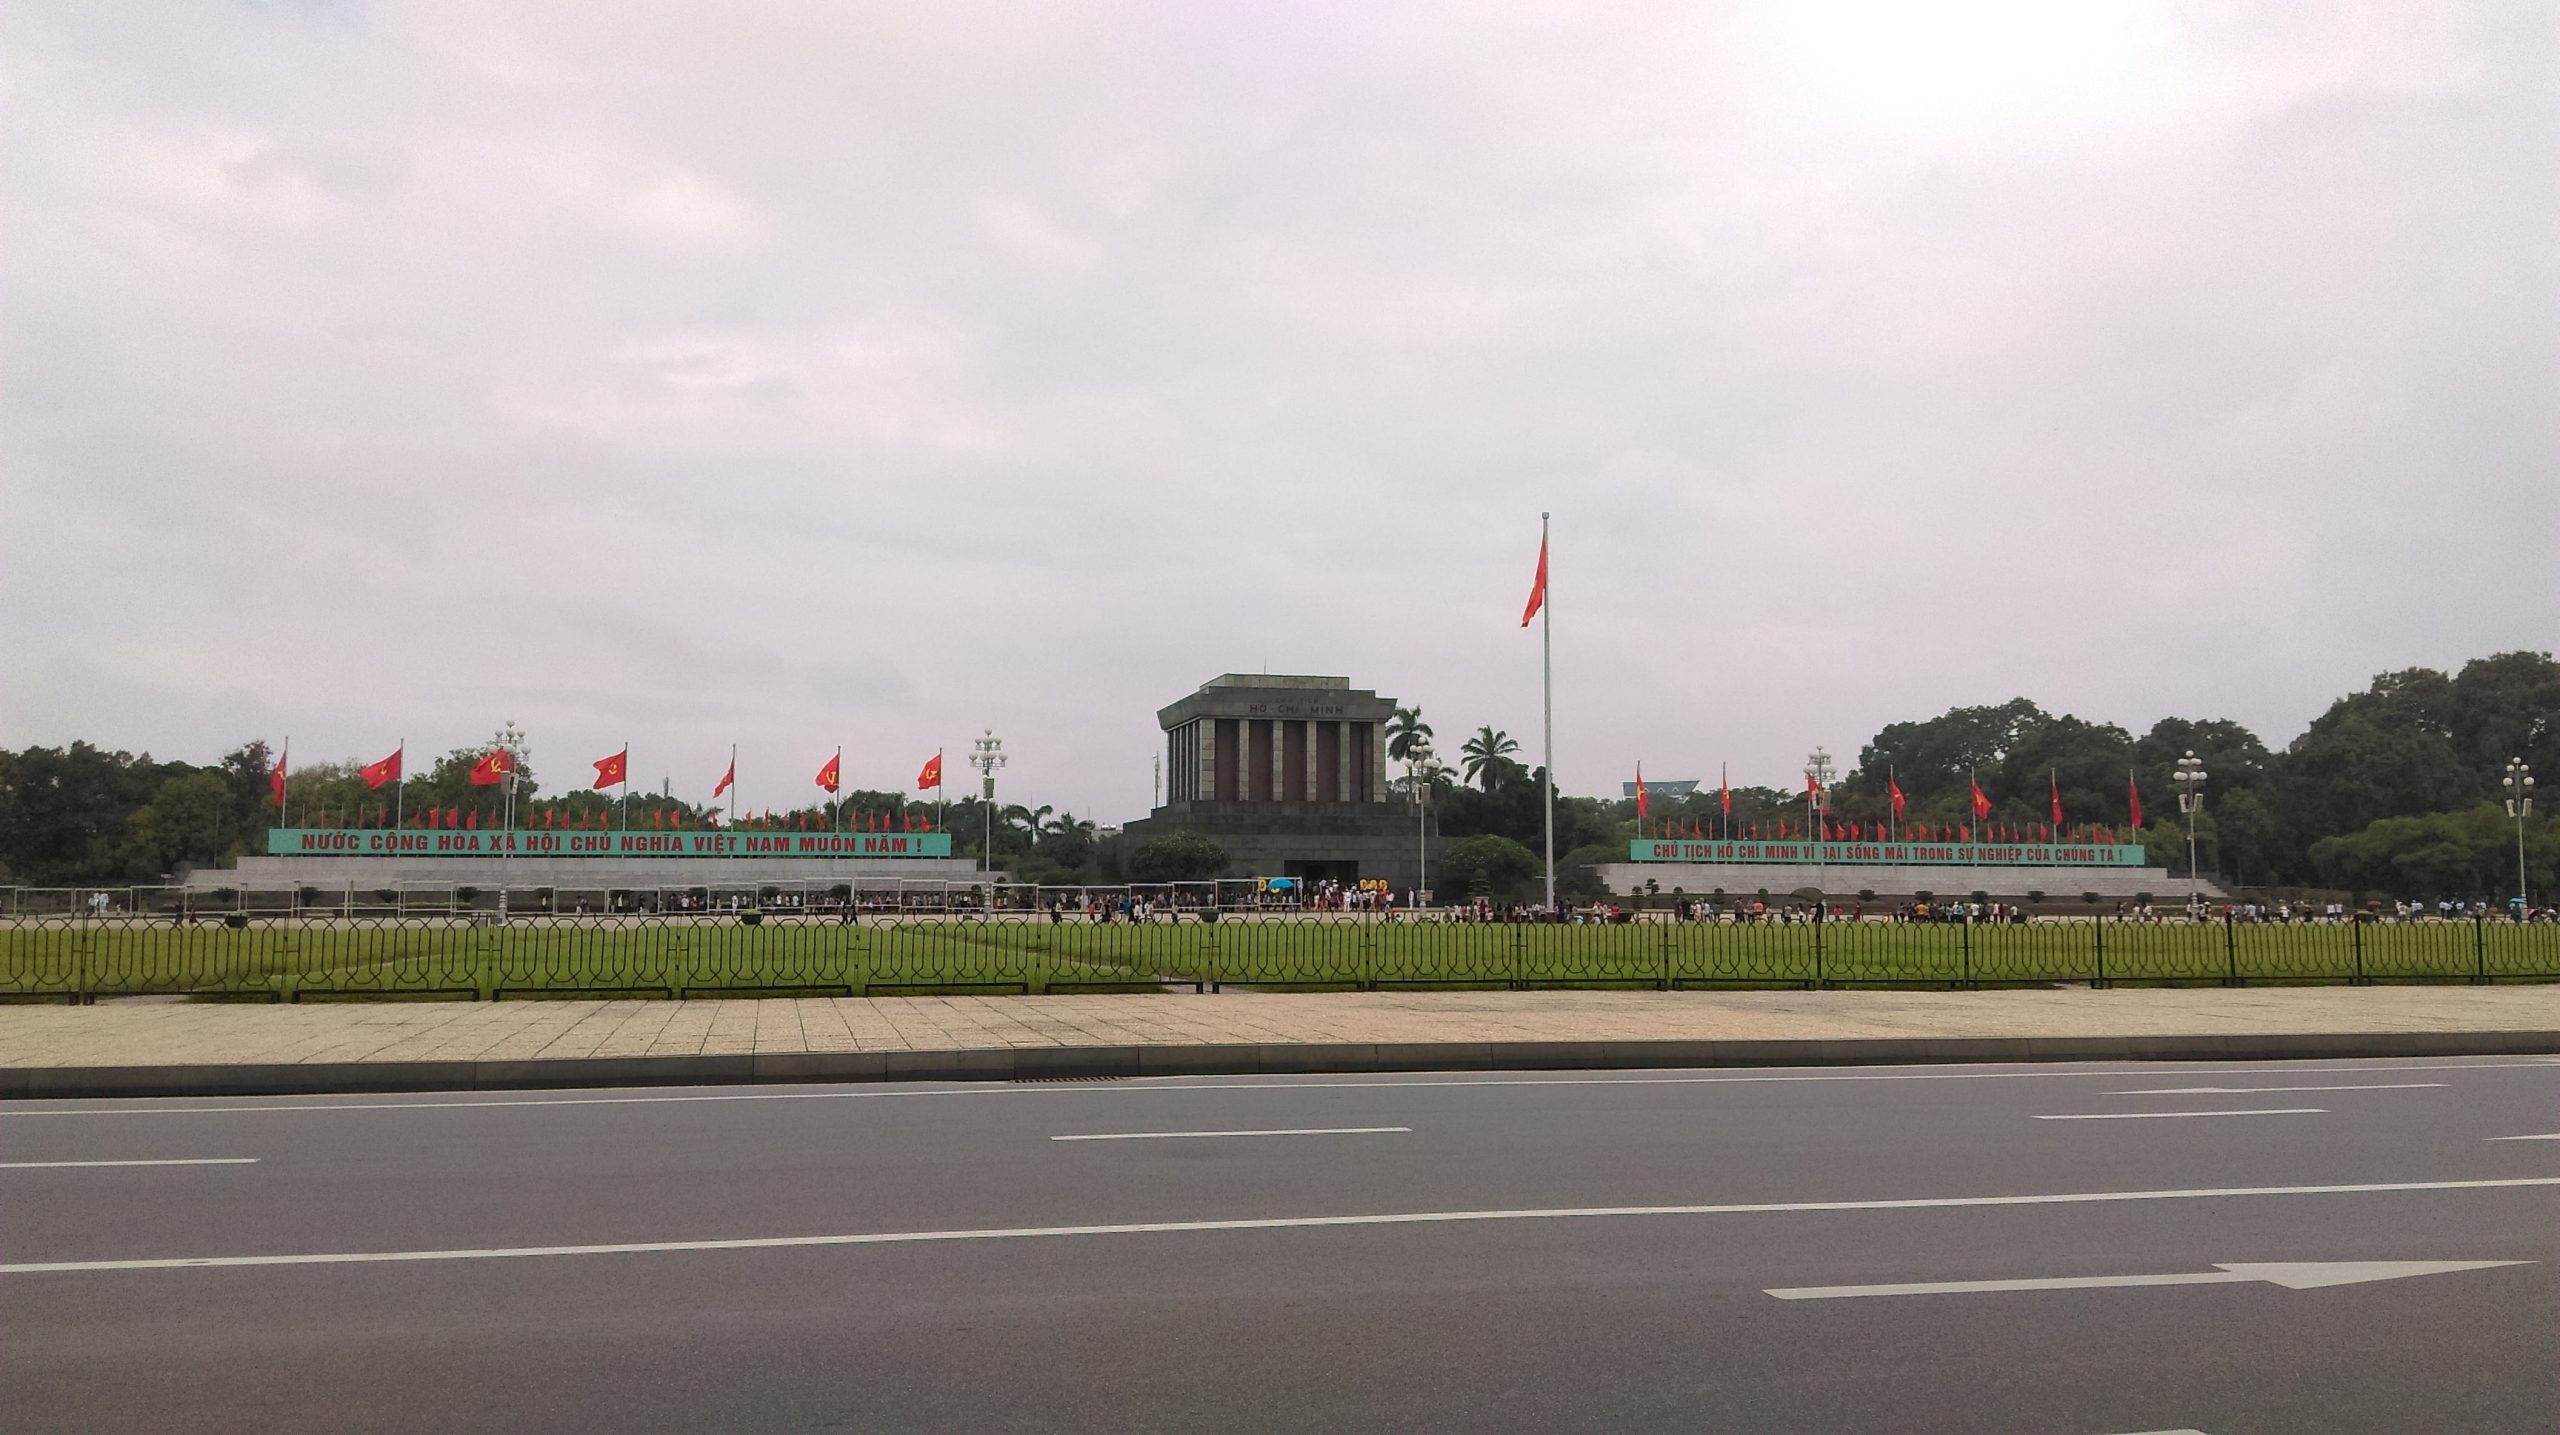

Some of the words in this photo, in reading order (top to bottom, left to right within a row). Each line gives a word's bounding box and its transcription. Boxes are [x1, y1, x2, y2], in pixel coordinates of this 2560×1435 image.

[301, 831, 360, 850] NƯỚC
[370, 832, 428, 853] CỘNG
[438, 832, 480, 850] HÒA
[490, 833, 517, 851] XÃ
[526, 833, 561, 854] HỘI
[570, 831, 611, 851] CHỦ
[621, 833, 683, 851] NGHĨA
[694, 834, 736, 854] VIỆT
[746, 836, 790, 852] NAM
[800, 834, 856, 852] MUÔN
[864, 834, 908, 853] NĂM
[1653, 841, 1678, 858] CHỦ
[1683, 844, 1712, 860] TỊCH
[1739, 843, 1759, 859] CHÍ
[1765, 845, 1798, 859] MINH
[1846, 843, 1880, 860] SỐNG
[1913, 847, 1953, 861] TRONG
[1958, 847, 1974, 863] SỰ
[1978, 846, 2022, 863] NGHIỆP
[2027, 845, 2050, 861] CỦA
[2055, 845, 2095, 862] CHÚNG
[2100, 848, 2114, 862] TA
